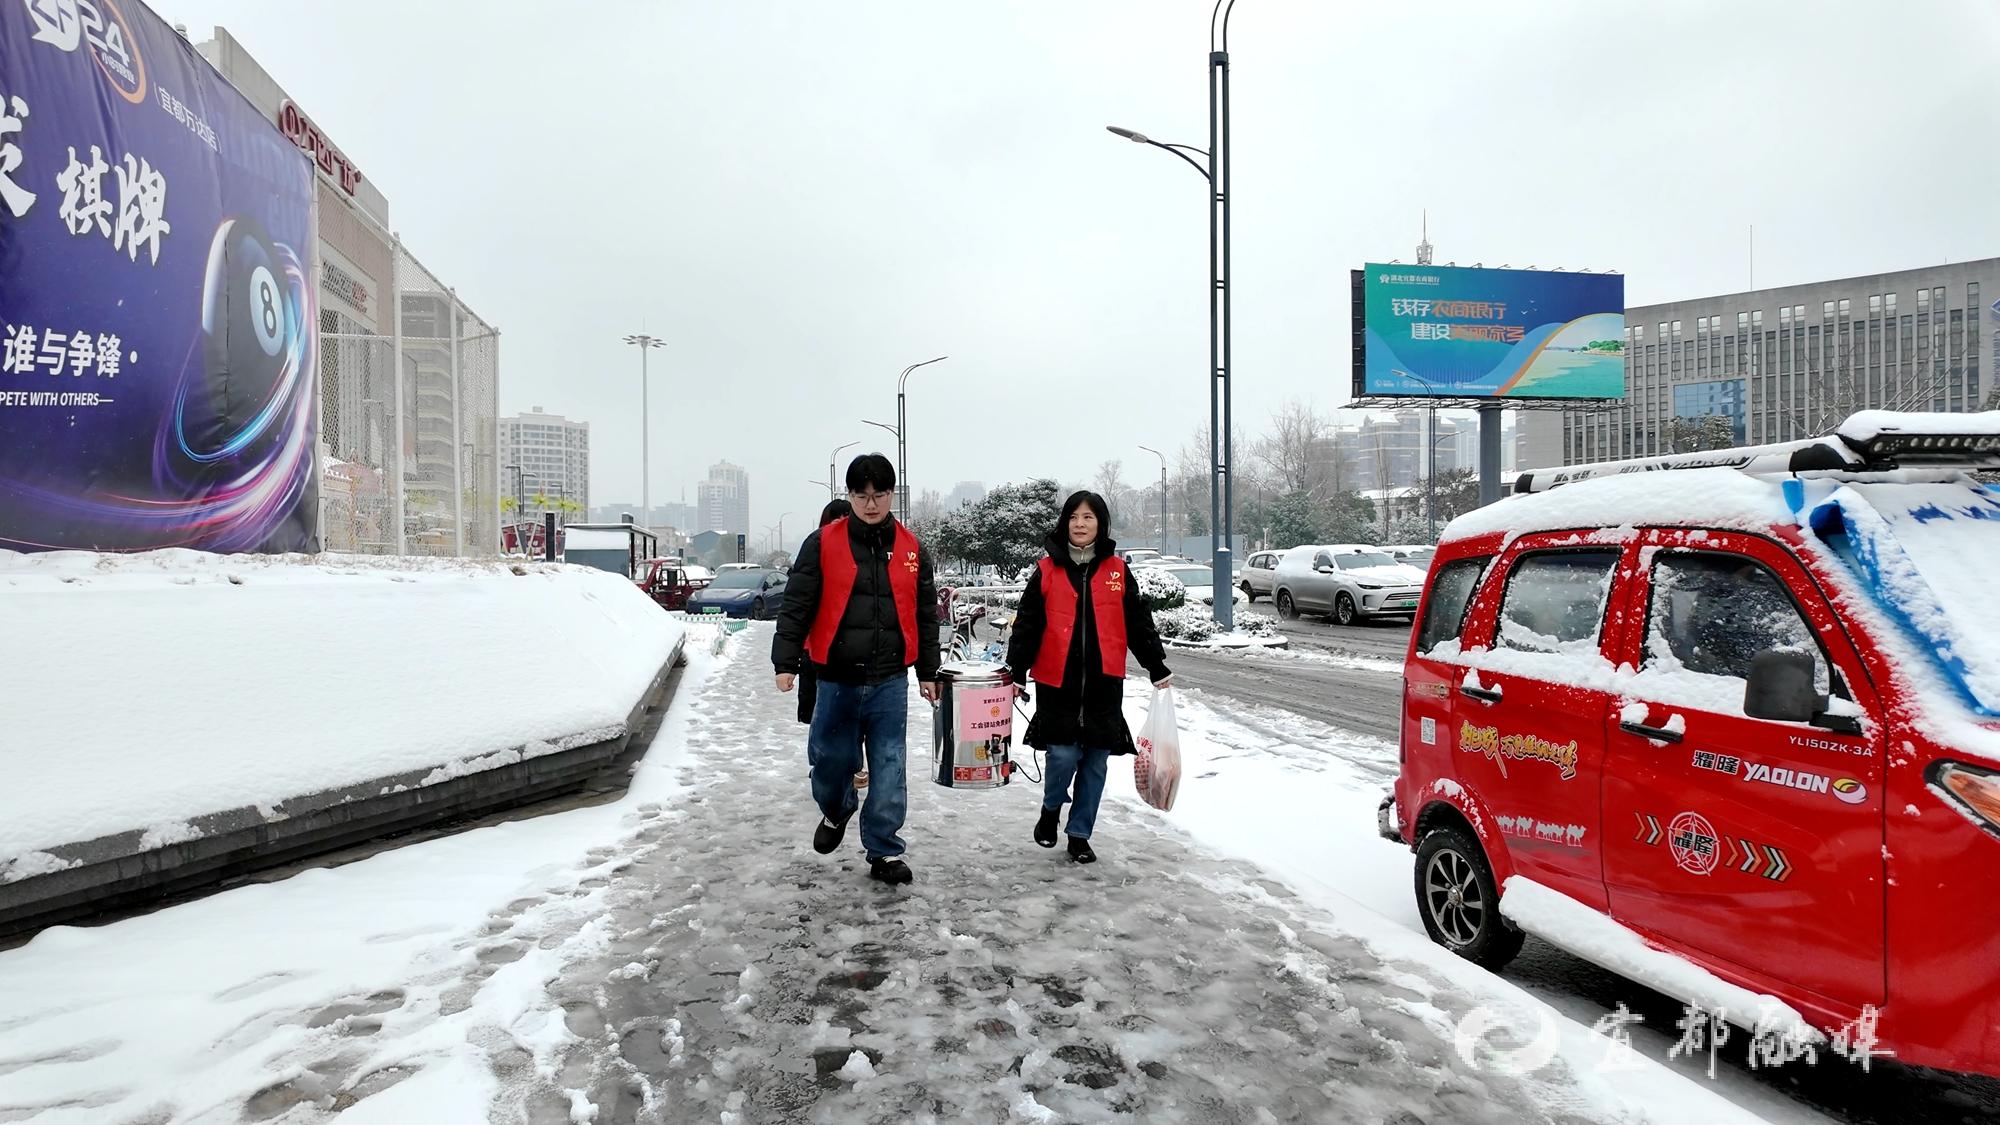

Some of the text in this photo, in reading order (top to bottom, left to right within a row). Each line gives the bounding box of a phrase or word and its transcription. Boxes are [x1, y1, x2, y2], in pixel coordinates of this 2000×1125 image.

[260, 280, 277, 339] 8
[30, 391, 58, 406] WITH
[1743, 761, 1829, 794] YAOLON
